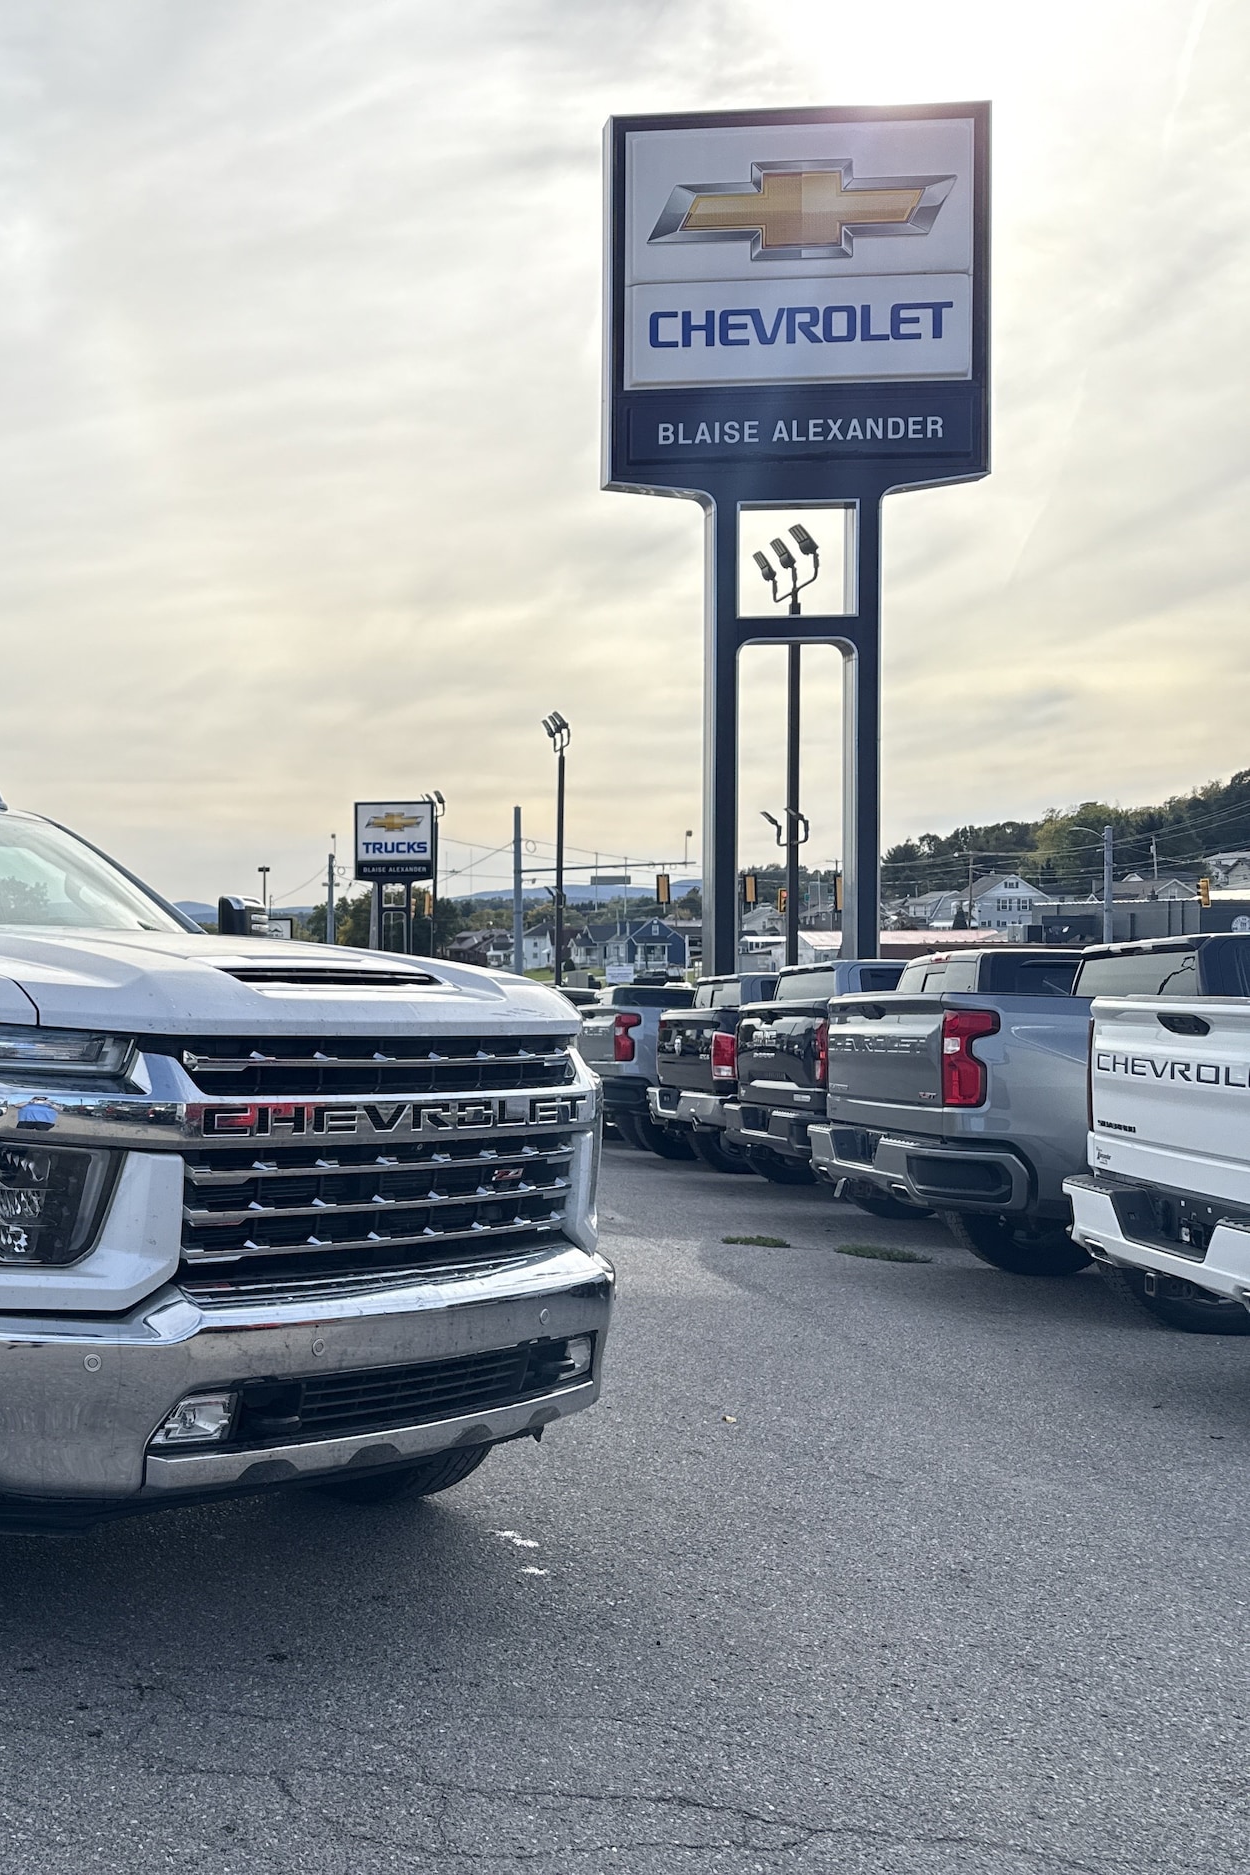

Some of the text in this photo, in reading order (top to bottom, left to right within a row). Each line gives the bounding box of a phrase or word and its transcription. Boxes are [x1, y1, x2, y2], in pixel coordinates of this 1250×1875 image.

[649, 301, 954, 348] CHEVROLET
[658, 416, 944, 445] BLAISE ALEXANDER
[362, 842, 427, 854] TRUCKS
[1097, 1053, 1250, 1089] CHEVROL
[202, 1095, 588, 1138] CHEVROLET
